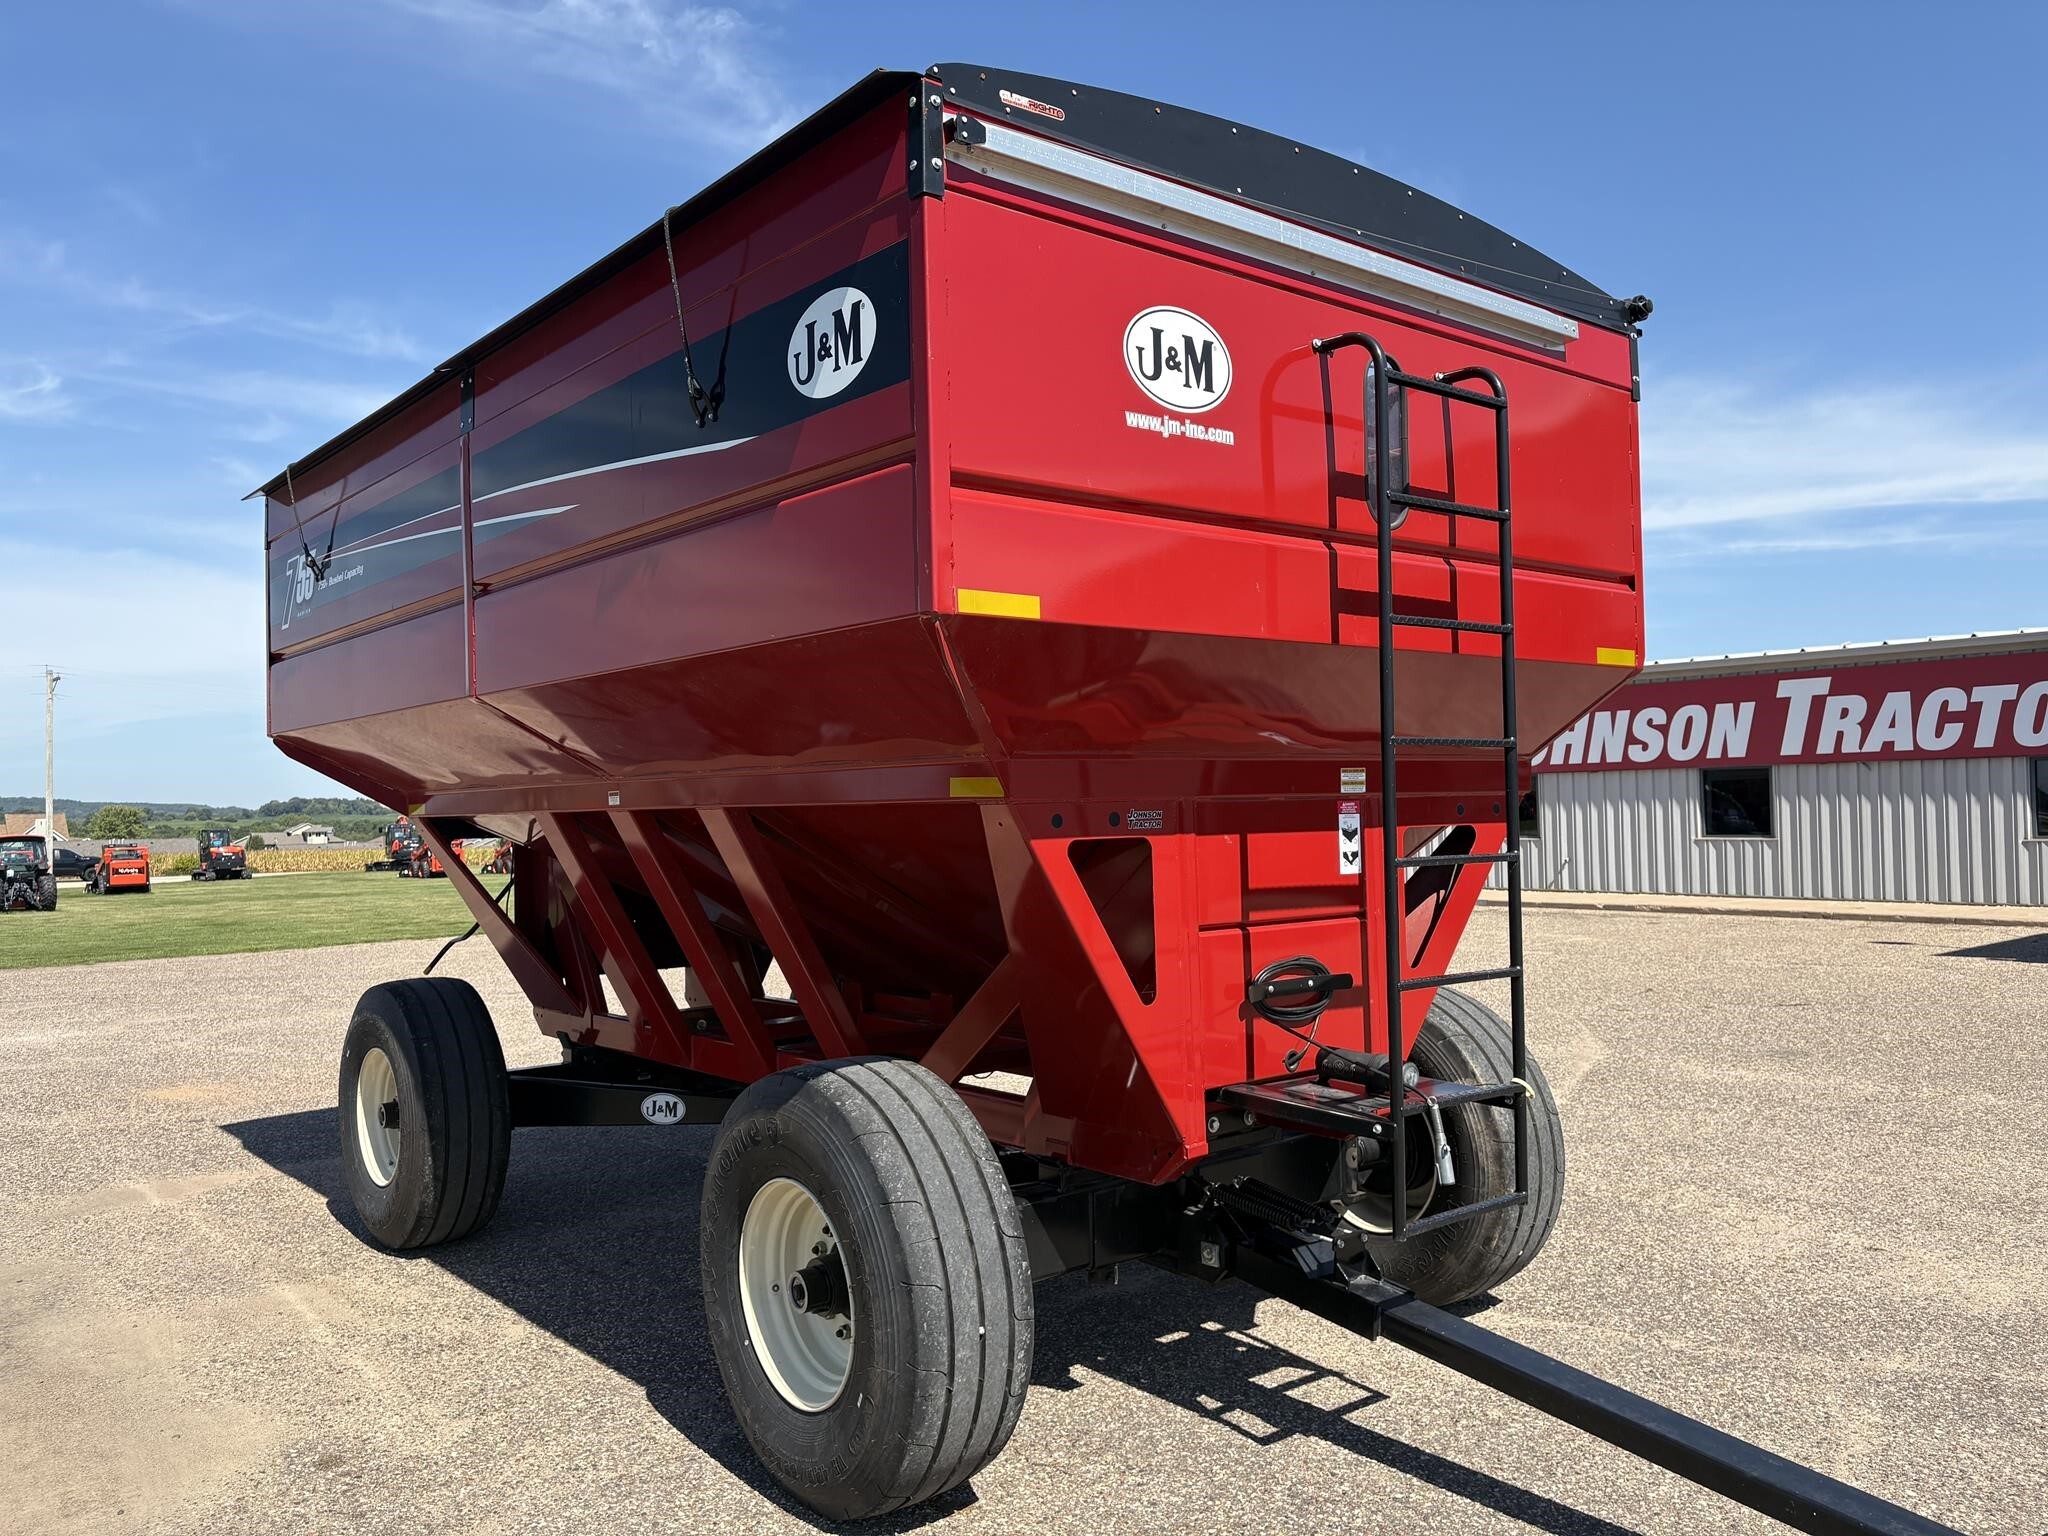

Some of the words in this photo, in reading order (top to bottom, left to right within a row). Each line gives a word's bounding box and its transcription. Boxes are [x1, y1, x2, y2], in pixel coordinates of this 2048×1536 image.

[794, 299, 863, 386] J&M
[1136, 326, 1215, 394] J&M
[1125, 411, 1235, 446] www.jm-inc.com
[329, 571, 343, 586] Bushel
[344, 564, 363, 580] Capacity
[1127, 809, 1163, 819] JOHNSON
[1128, 818, 1163, 830] TRACTOR
[646, 1100, 678, 1118] J&M
